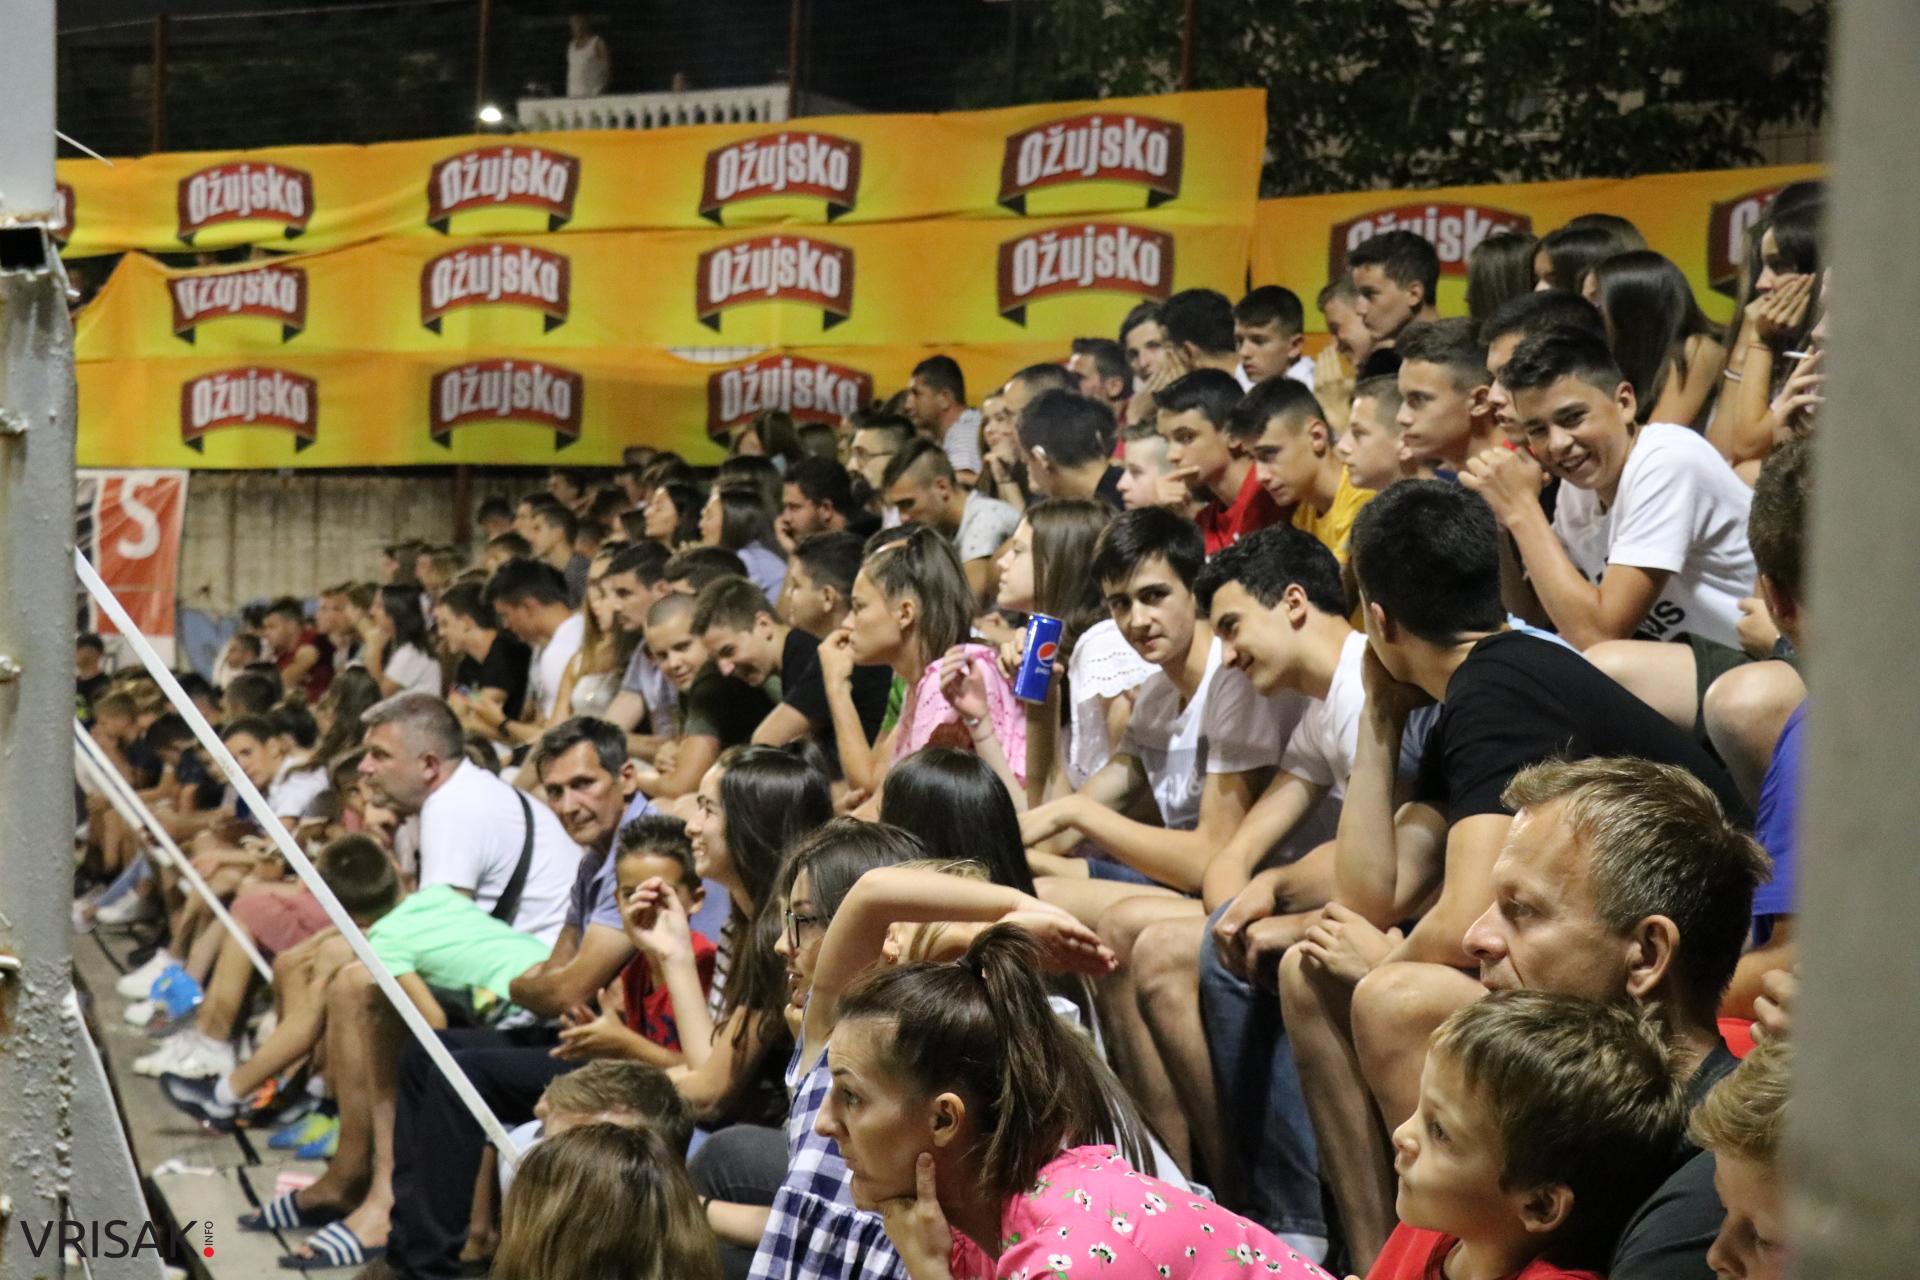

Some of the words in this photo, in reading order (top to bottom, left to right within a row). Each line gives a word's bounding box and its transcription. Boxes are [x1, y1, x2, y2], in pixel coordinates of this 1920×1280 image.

[440, 148, 568, 209] Ožujsko
[716, 134, 848, 200] Ožujsko
[1017, 117, 1168, 187] Ožujsko
[188, 164, 304, 225] Ožujsko
[432, 245, 559, 309] Ožujsko
[710, 238, 841, 303] Ožujsko
[1013, 225, 1160, 296] Ožujsko
[192, 369, 308, 428] Ožujsko
[441, 362, 571, 422] Ožujsko
